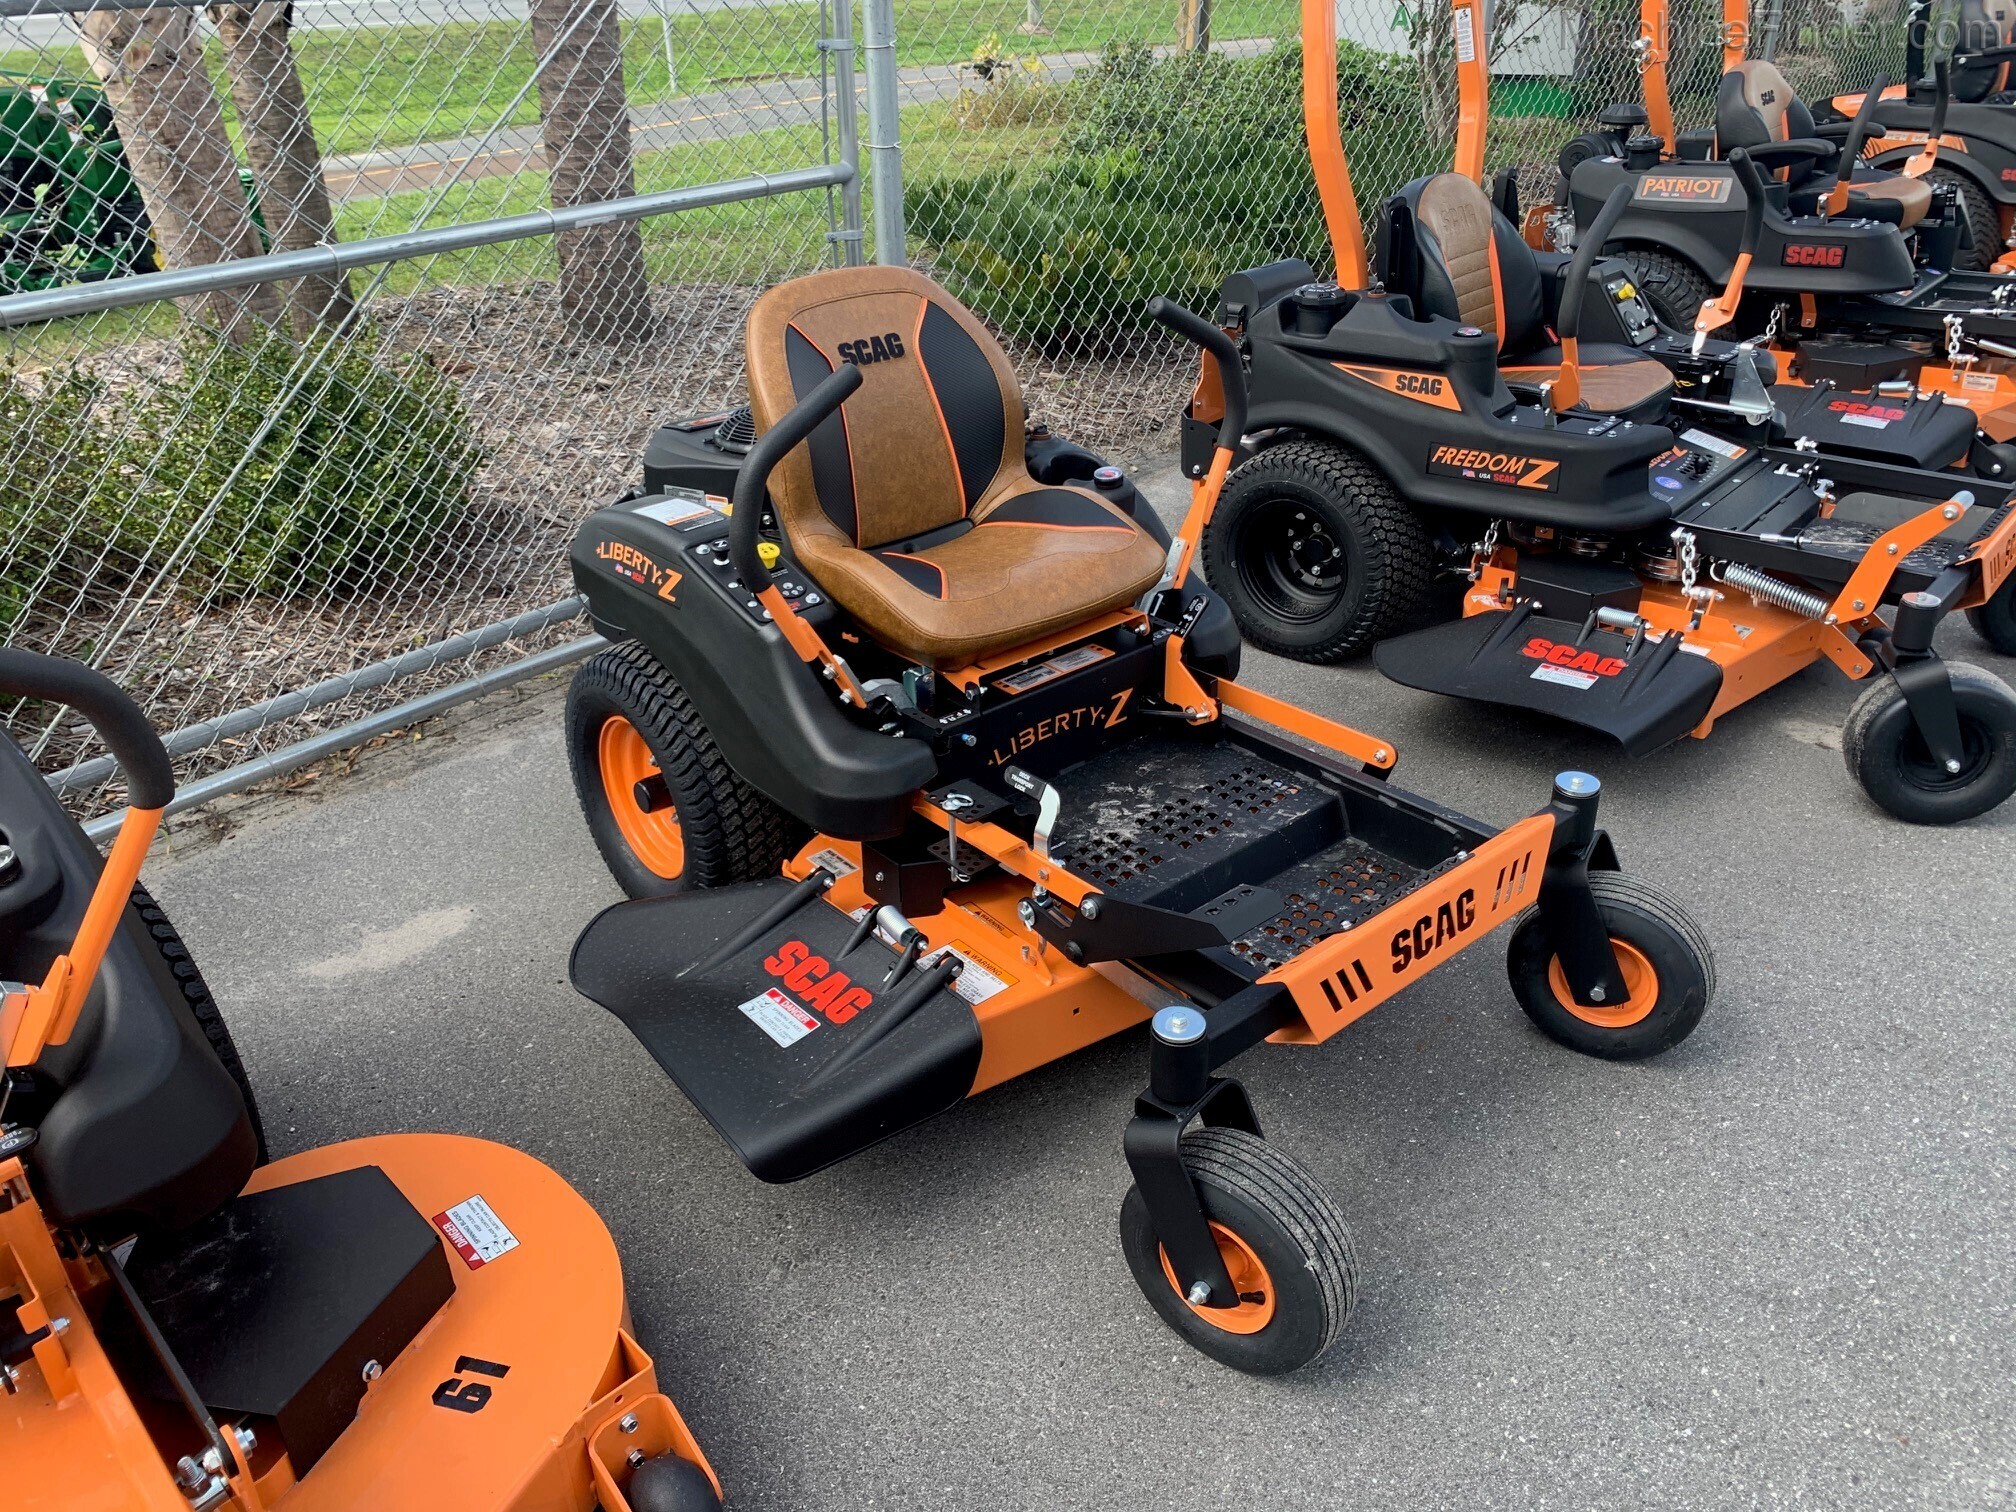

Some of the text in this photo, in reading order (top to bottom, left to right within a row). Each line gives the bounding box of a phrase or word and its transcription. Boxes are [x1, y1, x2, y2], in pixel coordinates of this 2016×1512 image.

[1641, 178, 1722, 199] PATRIOT
[1785, 245, 1843, 266] SCAG
[837, 332, 906, 366] SCAG
[1395, 374, 1443, 396] SCAG
[1828, 400, 1906, 421] SCAG
[1431, 446, 1527, 475] FREEDOM
[1492, 473, 1516, 484] SCAG
[600, 541, 662, 584] LIBERTY
[1521, 638, 1628, 677] SCAG
[994, 706, 1104, 765] LIBERTY
[1391, 888, 1475, 974] SCAG
[971, 954, 1003, 976] WARNING
[764, 940, 873, 1024] SCAG
[781, 1000, 811, 1024] DANGER
[442, 1222, 468, 1248] DANGER
[431, 1355, 511, 1414] 61
